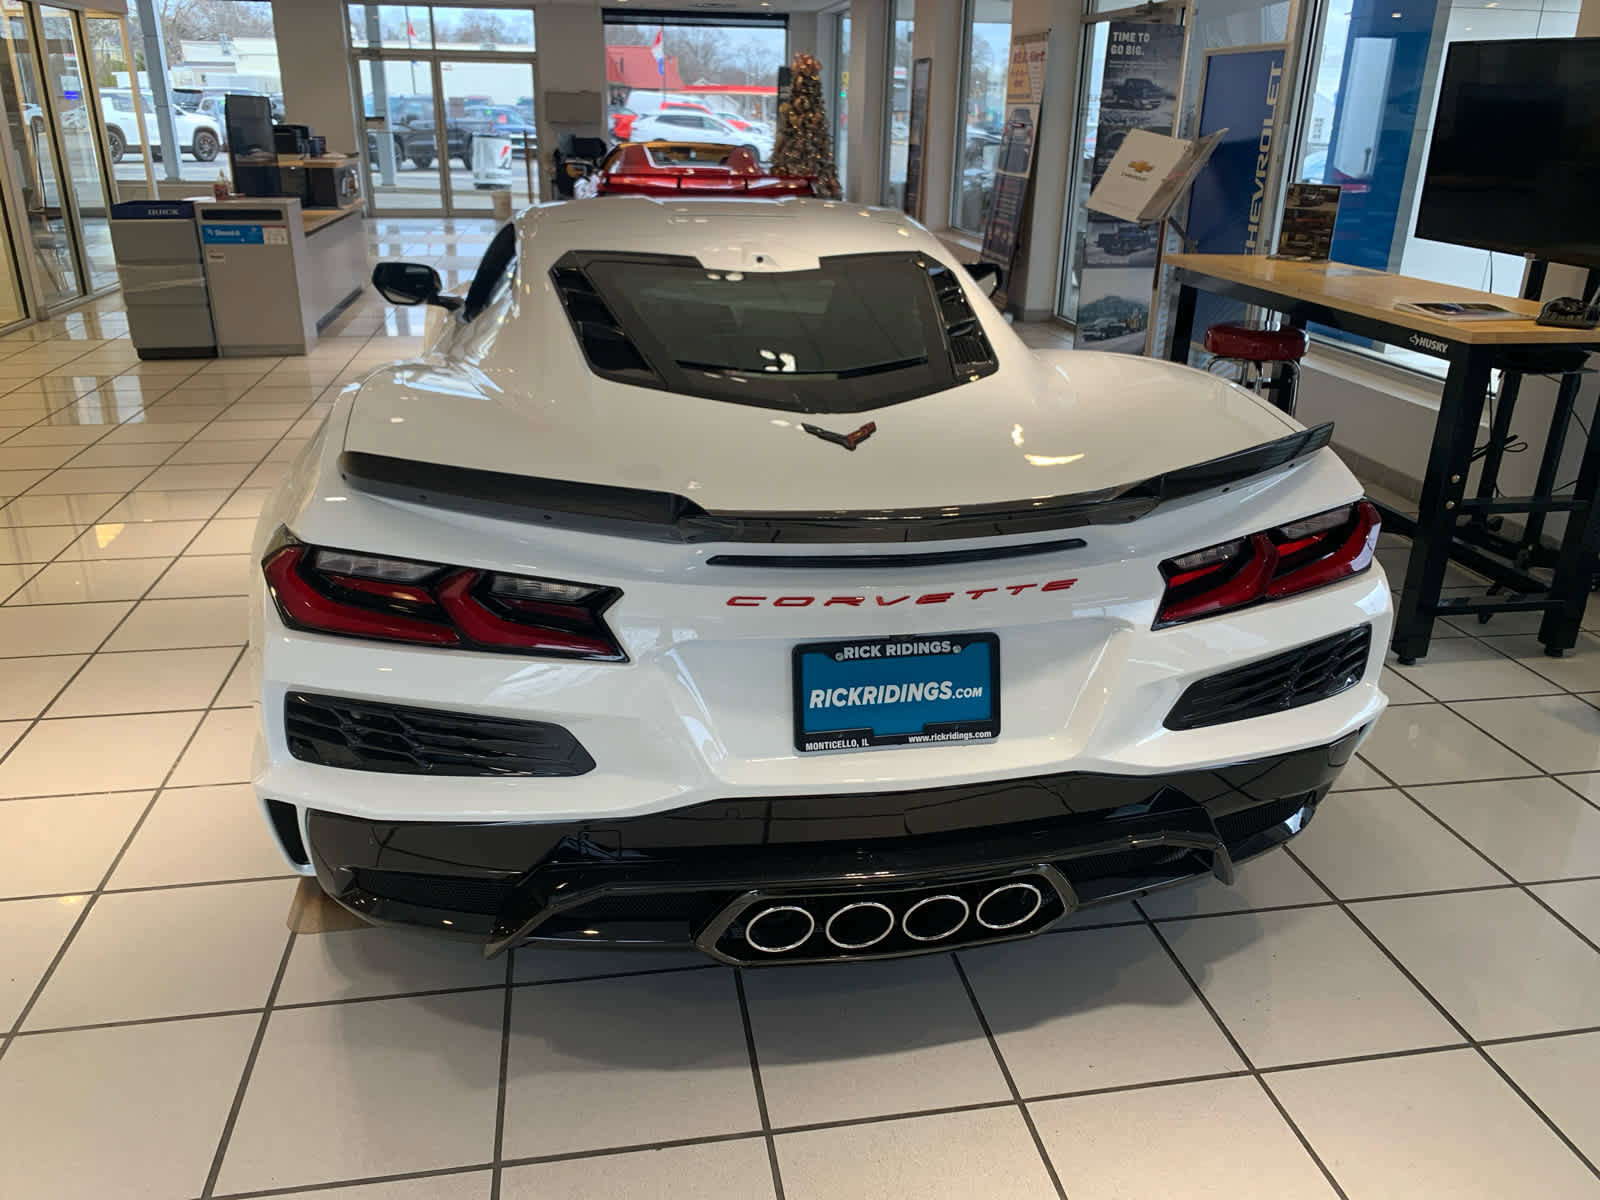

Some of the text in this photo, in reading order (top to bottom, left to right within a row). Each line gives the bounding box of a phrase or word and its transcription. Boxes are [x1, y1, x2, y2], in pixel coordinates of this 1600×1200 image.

[1112, 31, 1150, 43] TIME TO
[1110, 44, 1145, 56] GO BIG.
[1244, 60, 1282, 255] HEVROLET
[1418, 336, 1449, 353] HUSKY
[725, 578, 1079, 607] CORVETTE
[843, 641, 952, 660] RICK RIDINGS
[808, 680, 984, 709] RICKRIDINGS.COM
[805, 737, 870, 752] MONTICELLO, IL
[908, 730, 993, 743] www.rickridings.com
